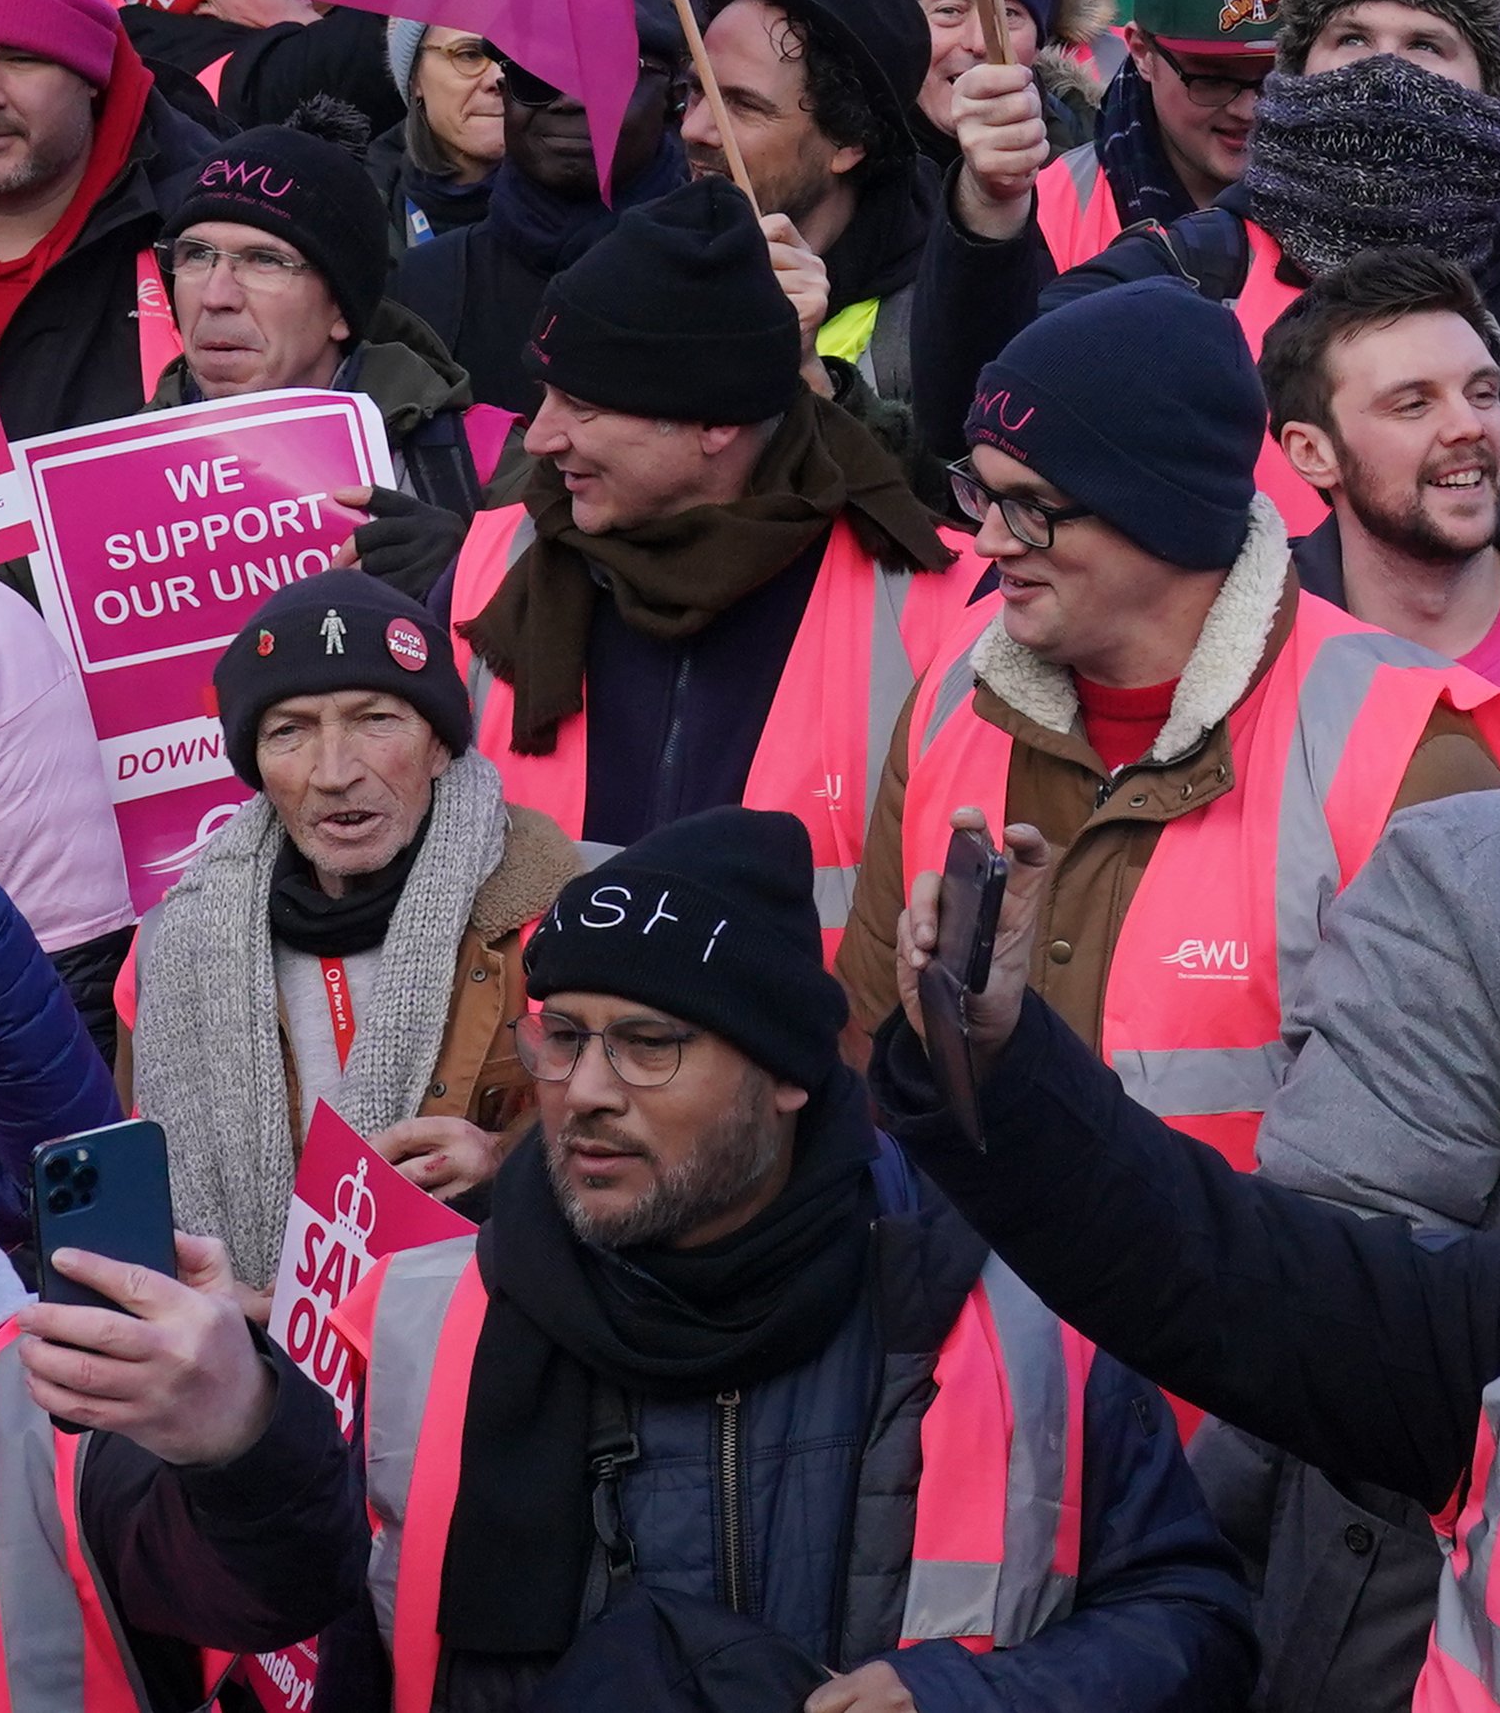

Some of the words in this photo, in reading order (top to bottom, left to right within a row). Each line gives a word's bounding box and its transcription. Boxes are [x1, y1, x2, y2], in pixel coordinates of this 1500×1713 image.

[201, 159, 294, 197] CWU
[163, 455, 245, 501] WE
[104, 492, 330, 572] SUPPORT
[91, 576, 201, 627] OUR
[388, 638, 427, 661] Tories
[394, 630, 421, 645] FUCK
[1180, 940, 1249, 971] CWU
